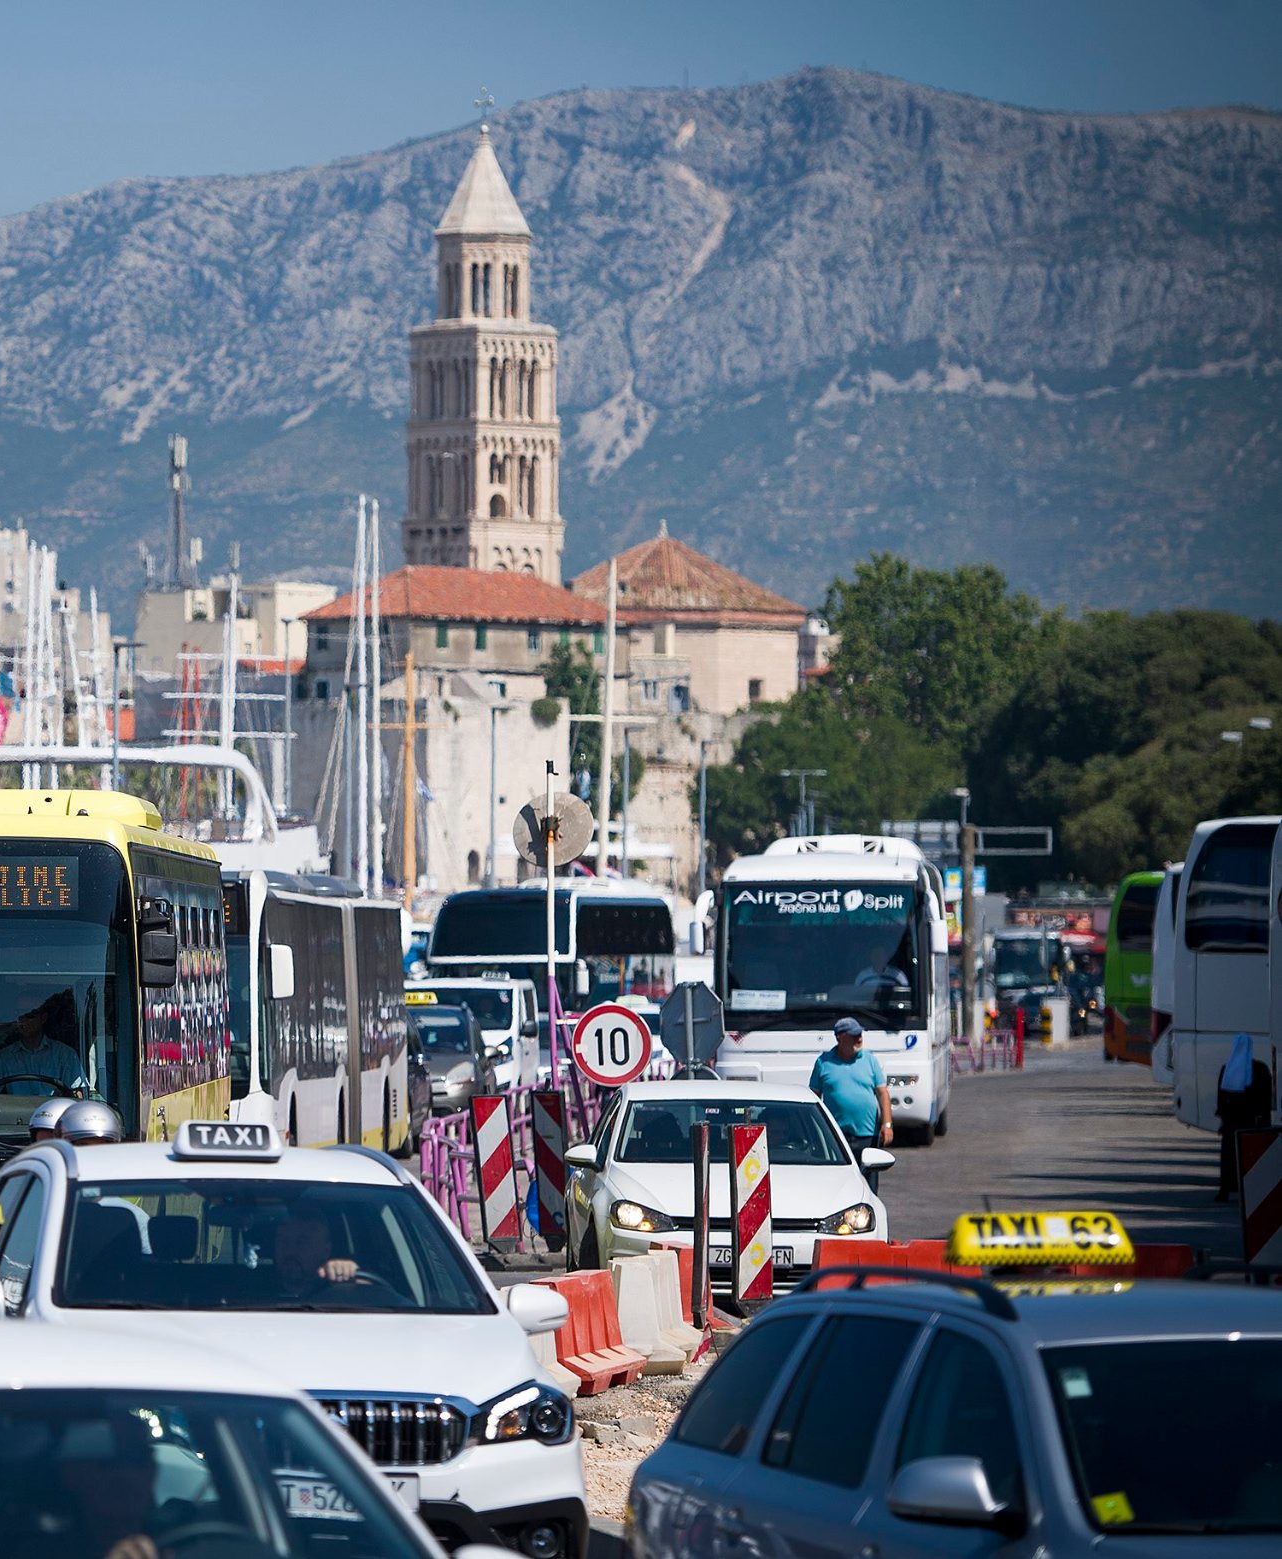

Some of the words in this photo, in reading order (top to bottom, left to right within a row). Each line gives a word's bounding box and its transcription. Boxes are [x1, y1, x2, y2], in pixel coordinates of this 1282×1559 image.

[733, 889, 842, 906] Airport
[863, 893, 905, 911] Split
[594, 1026, 630, 1066] 10
[195, 1126, 264, 1146] TAXI
[969, 1211, 1043, 1249] TAXI
[1070, 1211, 1114, 1250] 63
[715, 1249, 732, 1263] ZG
